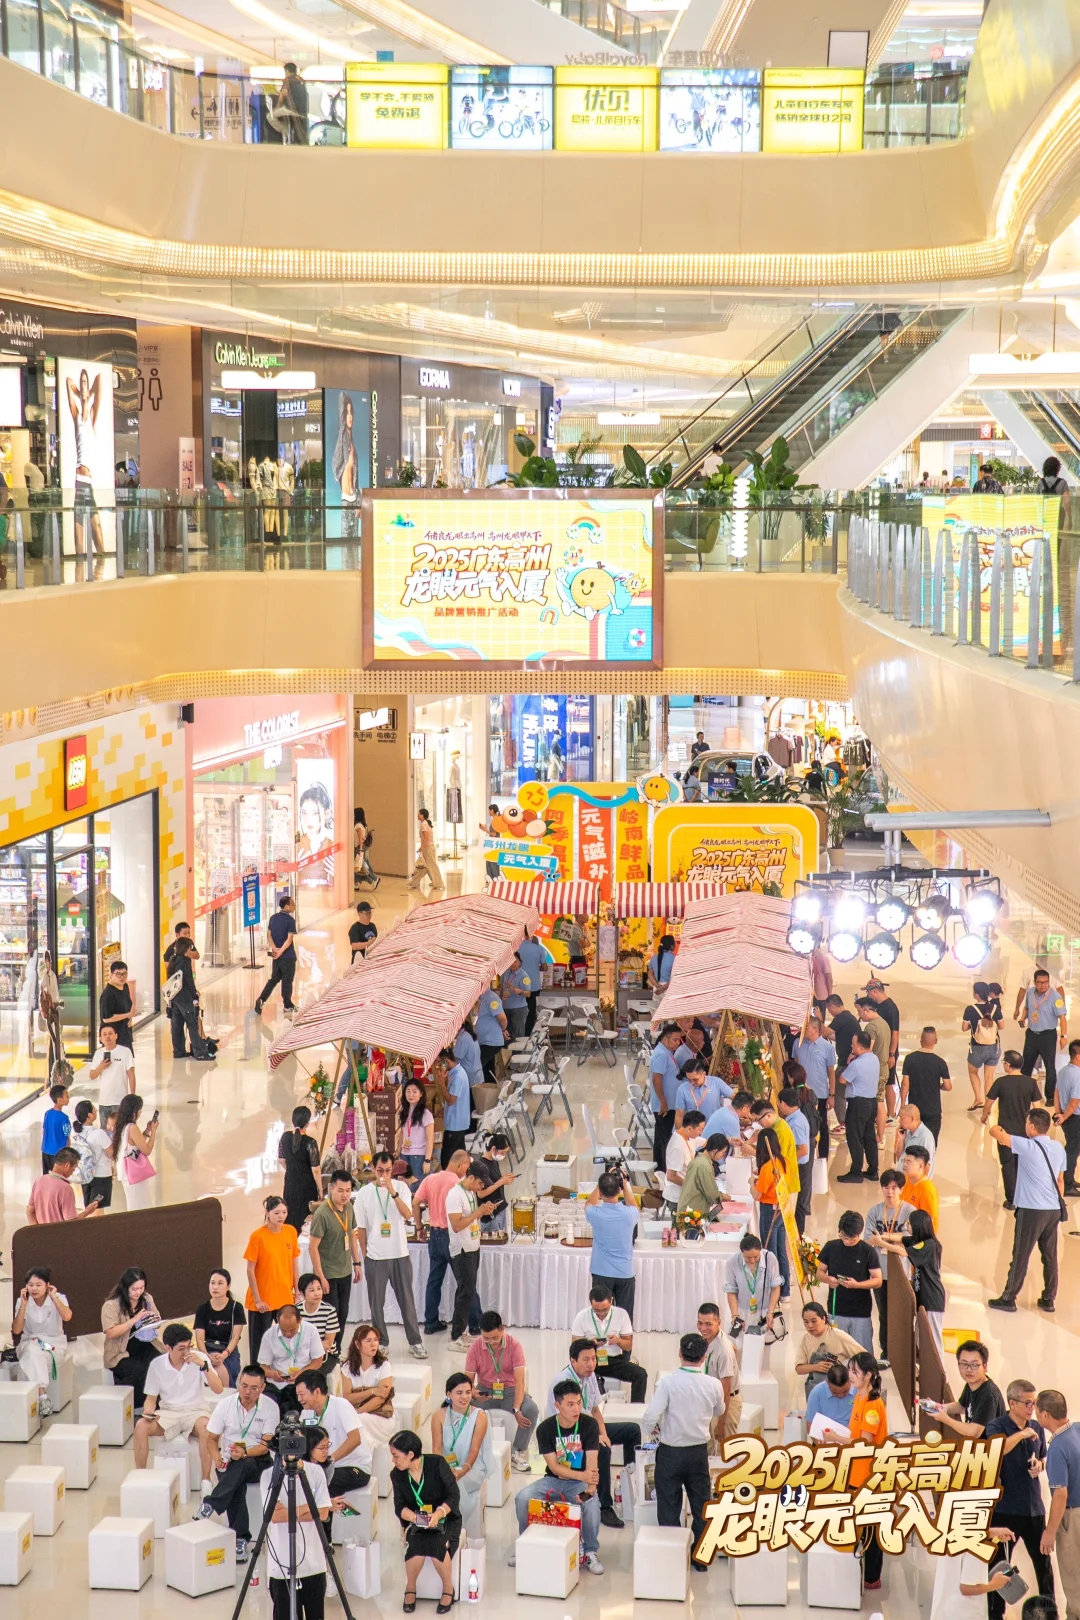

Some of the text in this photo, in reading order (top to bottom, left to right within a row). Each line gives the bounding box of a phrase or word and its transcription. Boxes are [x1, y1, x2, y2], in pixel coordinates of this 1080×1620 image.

[0, 309, 44, 340] Calvin Klein
[214, 341, 235, 365] Calvin
[235, 344, 251, 367] Klein
[370, 390, 379, 489] Calvin Klein Jean
[412, 542, 552, 573] 2025广东高州
[400, 568, 550, 607] 龙眼元气入厦
[433, 606, 520, 618] 品牌营销推广活动
[482, 839, 530, 853] 高州龙眼
[581, 808, 609, 881] 元气滋补
[618, 808, 646, 881] 岭南鲜品
[691, 847, 787, 869] 2025广东高州
[502, 853, 553, 869] 元气入厦
[686, 864, 787, 892] 龙眼元气入厦
